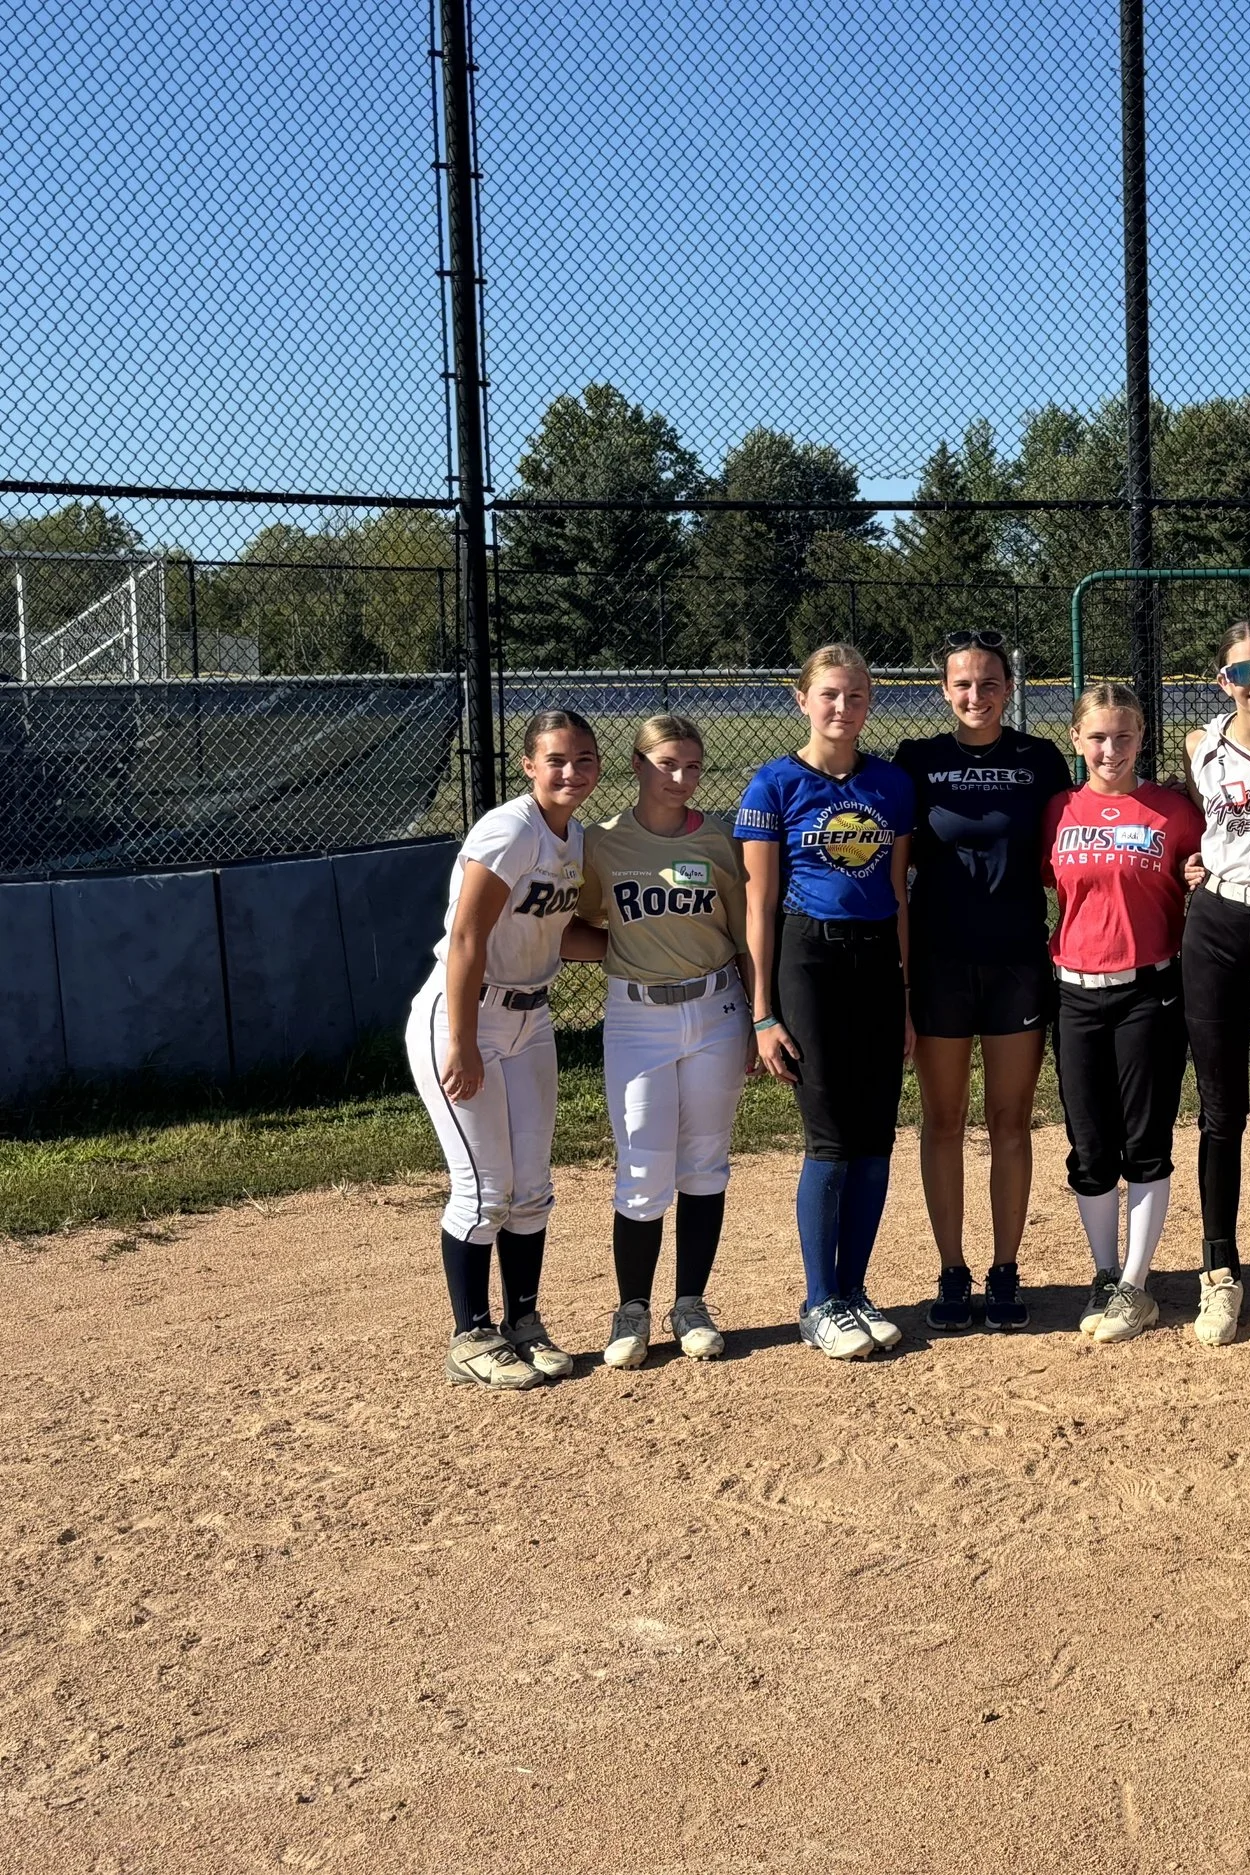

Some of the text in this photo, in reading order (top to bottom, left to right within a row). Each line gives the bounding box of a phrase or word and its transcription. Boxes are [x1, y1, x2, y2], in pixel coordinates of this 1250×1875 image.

[928, 769, 1010, 784] WE ARE
[951, 783, 1013, 791] SOFTBALL
[812, 800, 889, 829] LADY LIGHTNING
[803, 829, 895, 847] DEEP RUN
[1058, 825, 1166, 858] MYSS
[1058, 853, 1162, 872] FASTPITCH
[512, 880, 581, 918] ROC
[612, 879, 717, 925] ROCK
